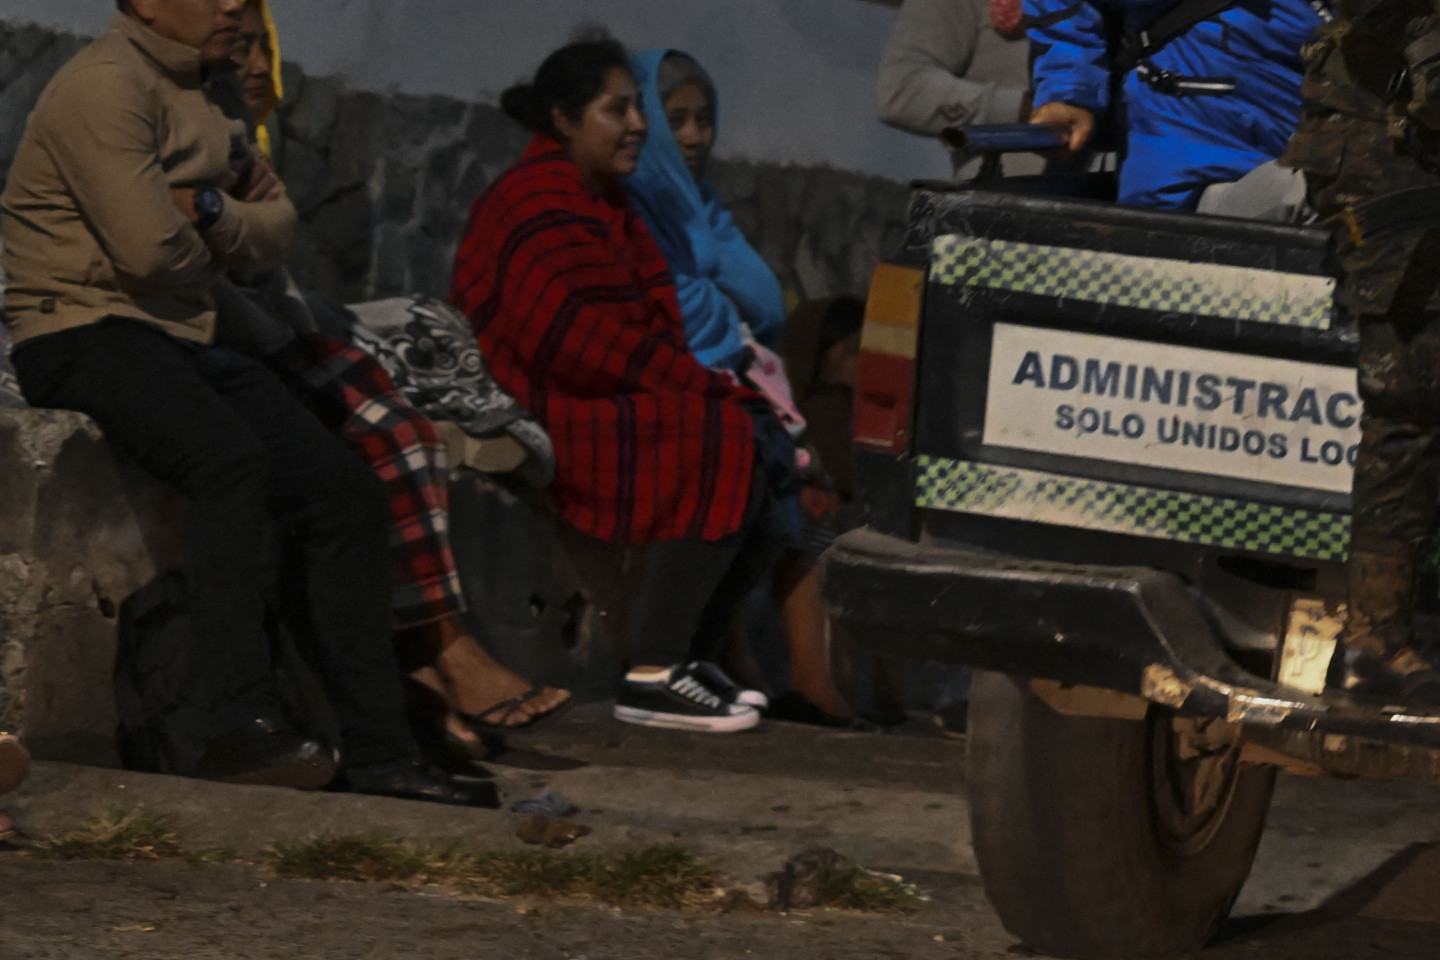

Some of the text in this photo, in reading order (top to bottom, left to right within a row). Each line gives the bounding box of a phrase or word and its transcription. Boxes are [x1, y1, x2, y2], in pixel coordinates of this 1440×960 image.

[1012, 351, 1358, 427] ADMINISTRAC
[1055, 405, 1145, 438] SOLO
[1157, 418, 1288, 459] UNIDOS
